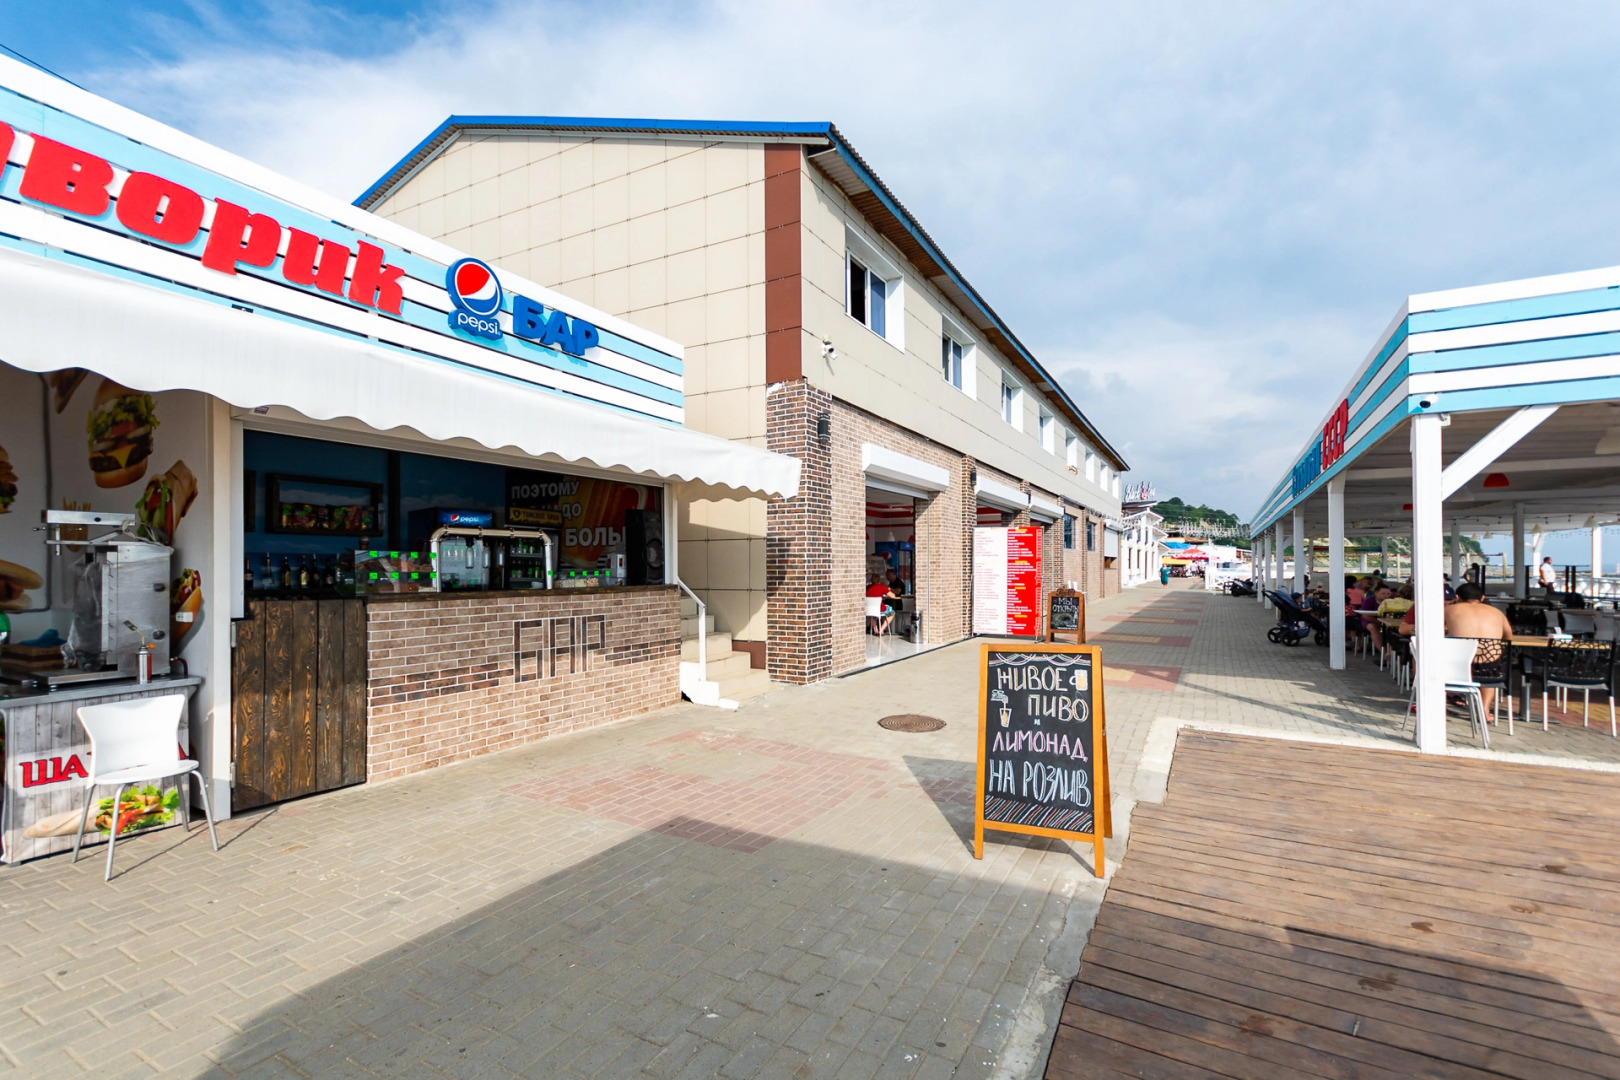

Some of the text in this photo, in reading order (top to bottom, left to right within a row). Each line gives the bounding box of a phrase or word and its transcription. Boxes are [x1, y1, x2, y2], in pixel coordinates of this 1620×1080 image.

[0, 120, 405, 316] ворик
[457, 312, 500, 335] pepsi
[513, 295, 599, 356] БАР
[511, 481, 580, 499] ПОЭТОМУ
[460, 515, 479, 524] pepsi
[1058, 597, 1073, 606] МЫ
[514, 614, 605, 683] БАР
[997, 666, 1068, 692] ЖИВОЕ
[1027, 694, 1089, 722] ПИВО
[992, 730, 1089, 762] ЛИМОНАД
[988, 759, 1091, 808] НА РОЗЛИВ
